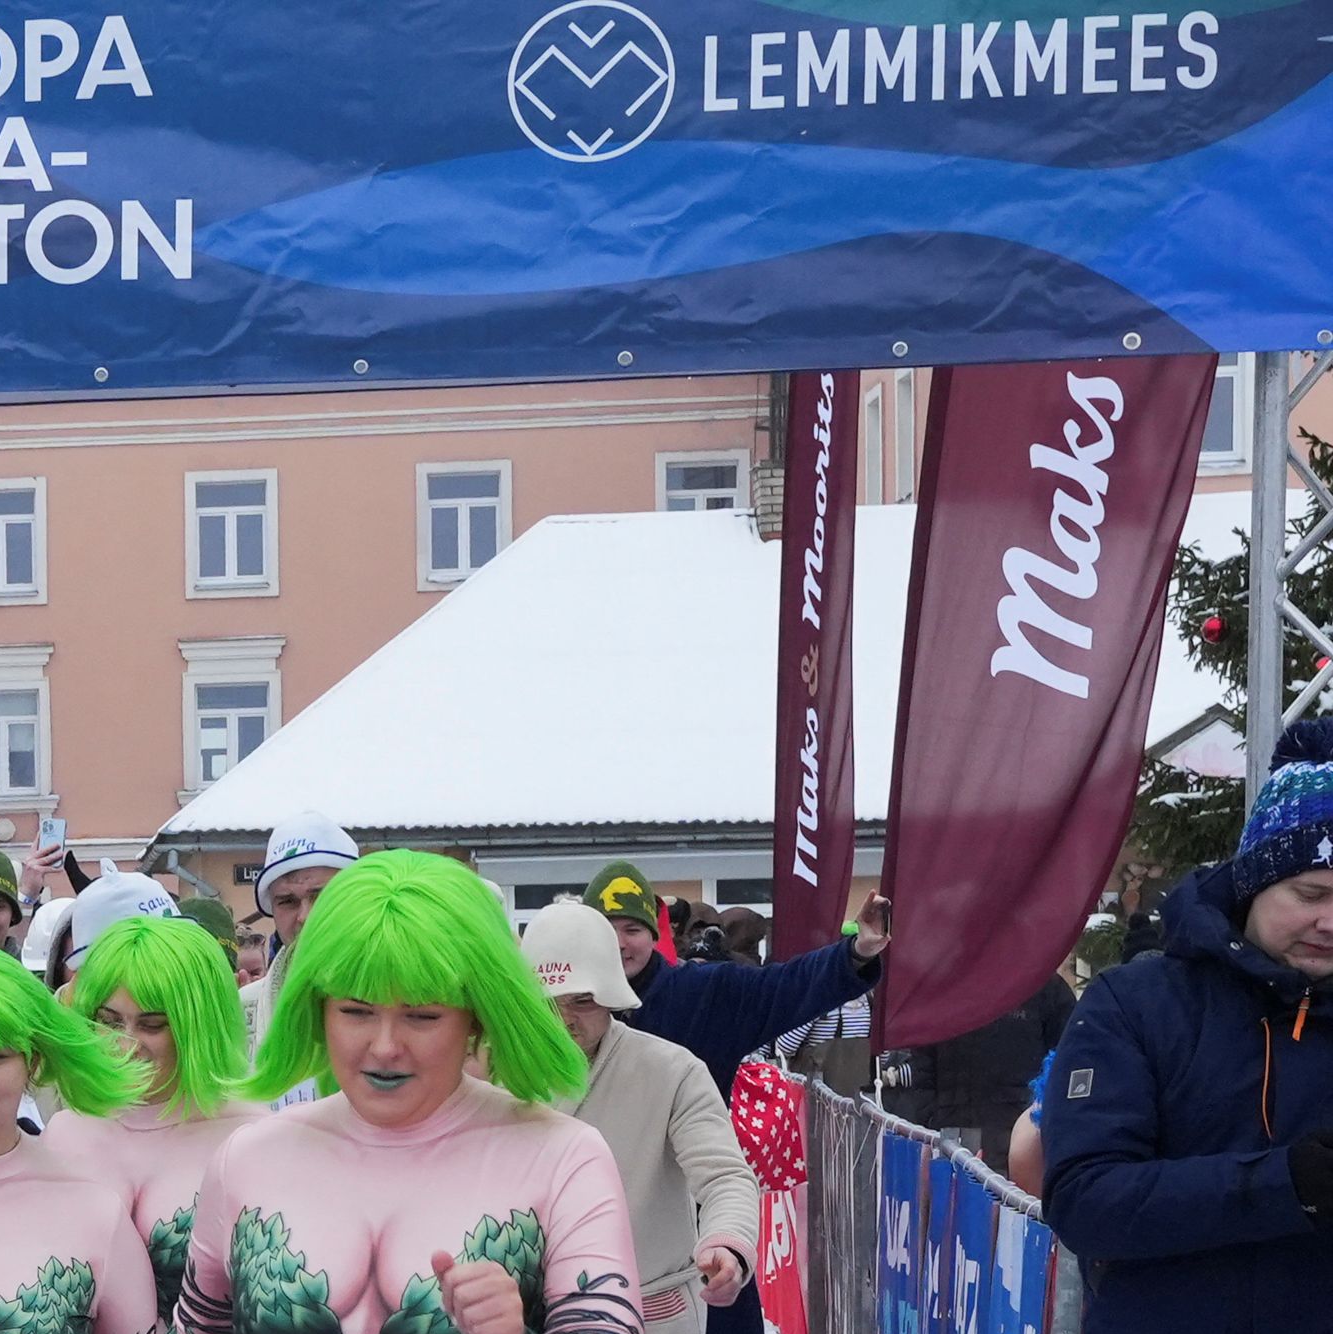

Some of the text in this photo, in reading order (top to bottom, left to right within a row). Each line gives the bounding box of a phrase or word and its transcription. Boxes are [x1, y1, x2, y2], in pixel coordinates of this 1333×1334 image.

[703, 10, 1219, 112] LEMMIKMEES
[802, 372, 835, 631] Moorits
[990, 370, 1125, 699] Maks
[793, 706, 820, 888] Maks
[538, 974, 566, 985] OSS
